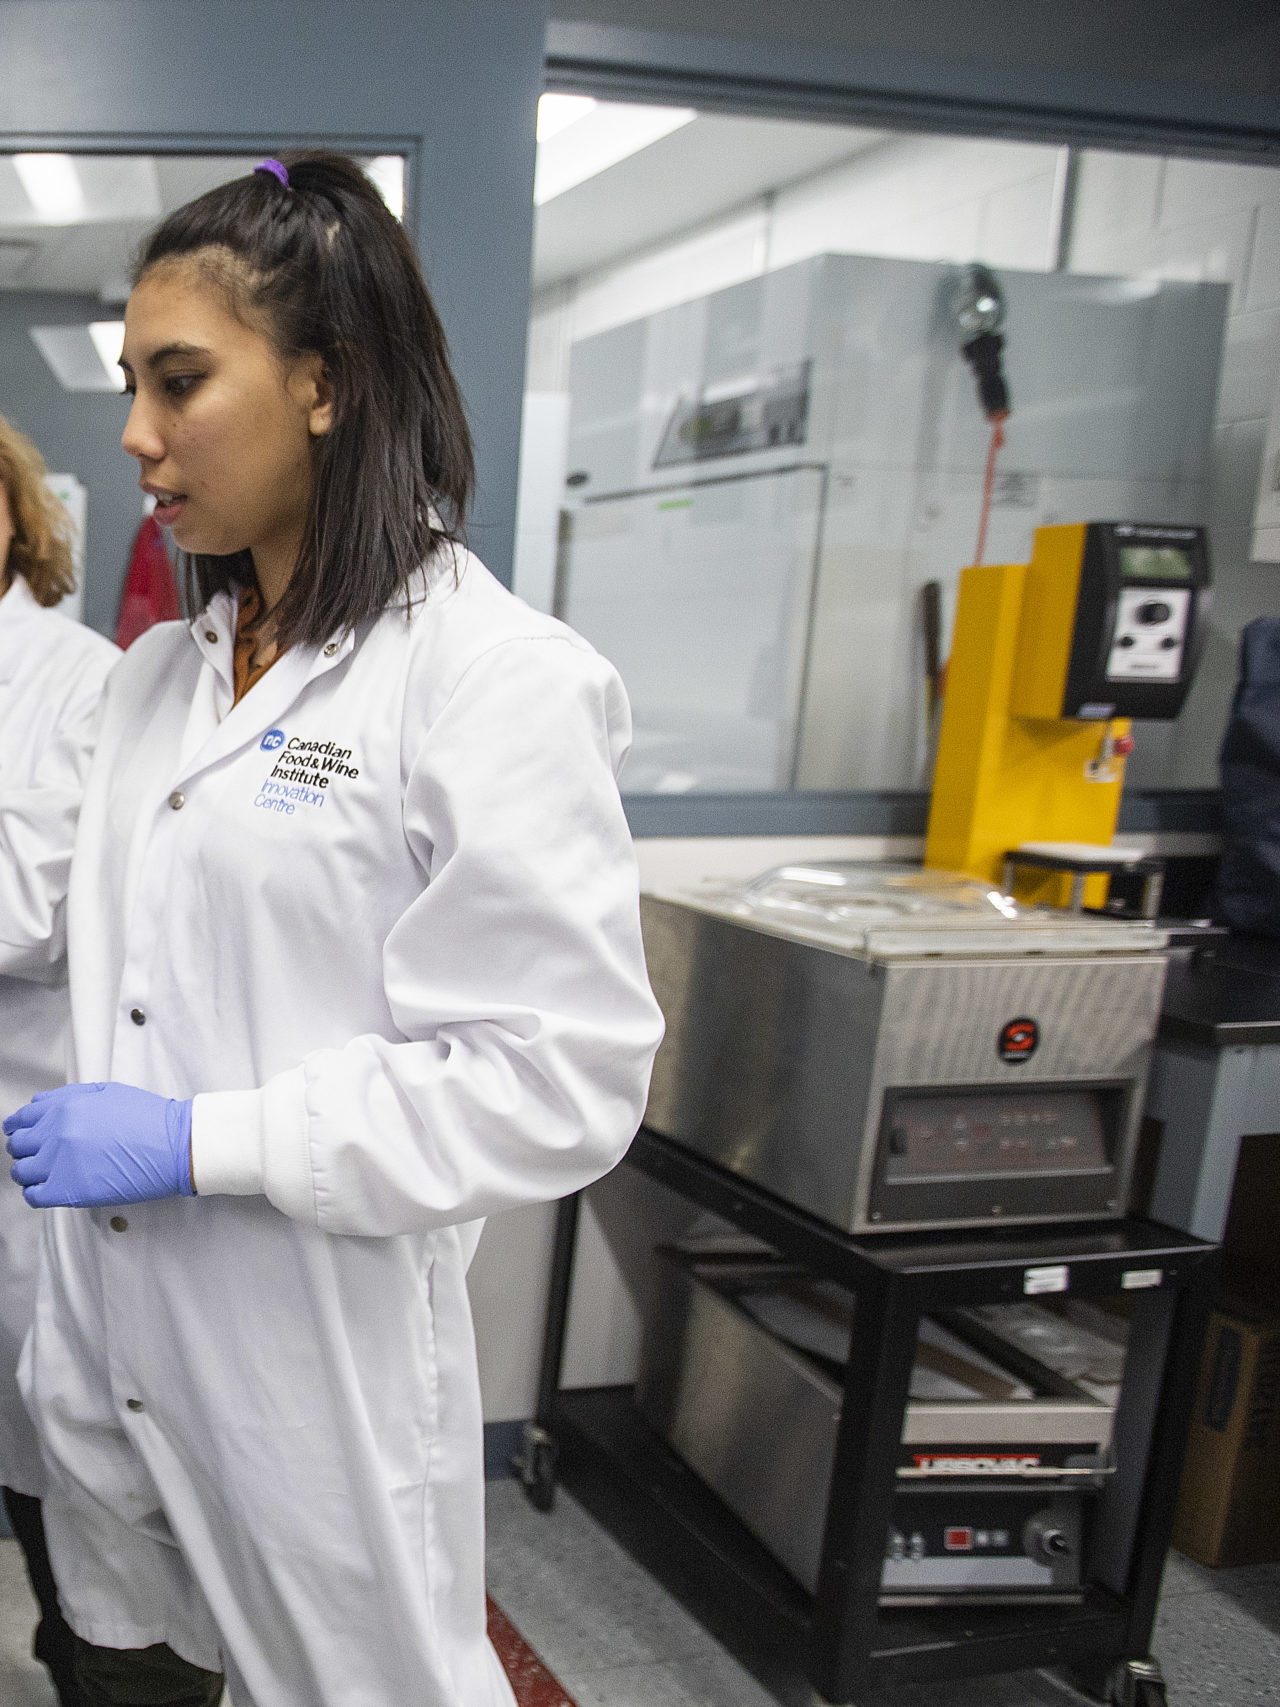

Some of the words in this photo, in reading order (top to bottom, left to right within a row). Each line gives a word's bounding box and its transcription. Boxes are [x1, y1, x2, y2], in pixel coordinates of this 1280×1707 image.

[287, 737, 352, 759] Canadian
[270, 764, 329, 788] Institute
[254, 793, 296, 815] Centre
[261, 779, 324, 808] Innovation
